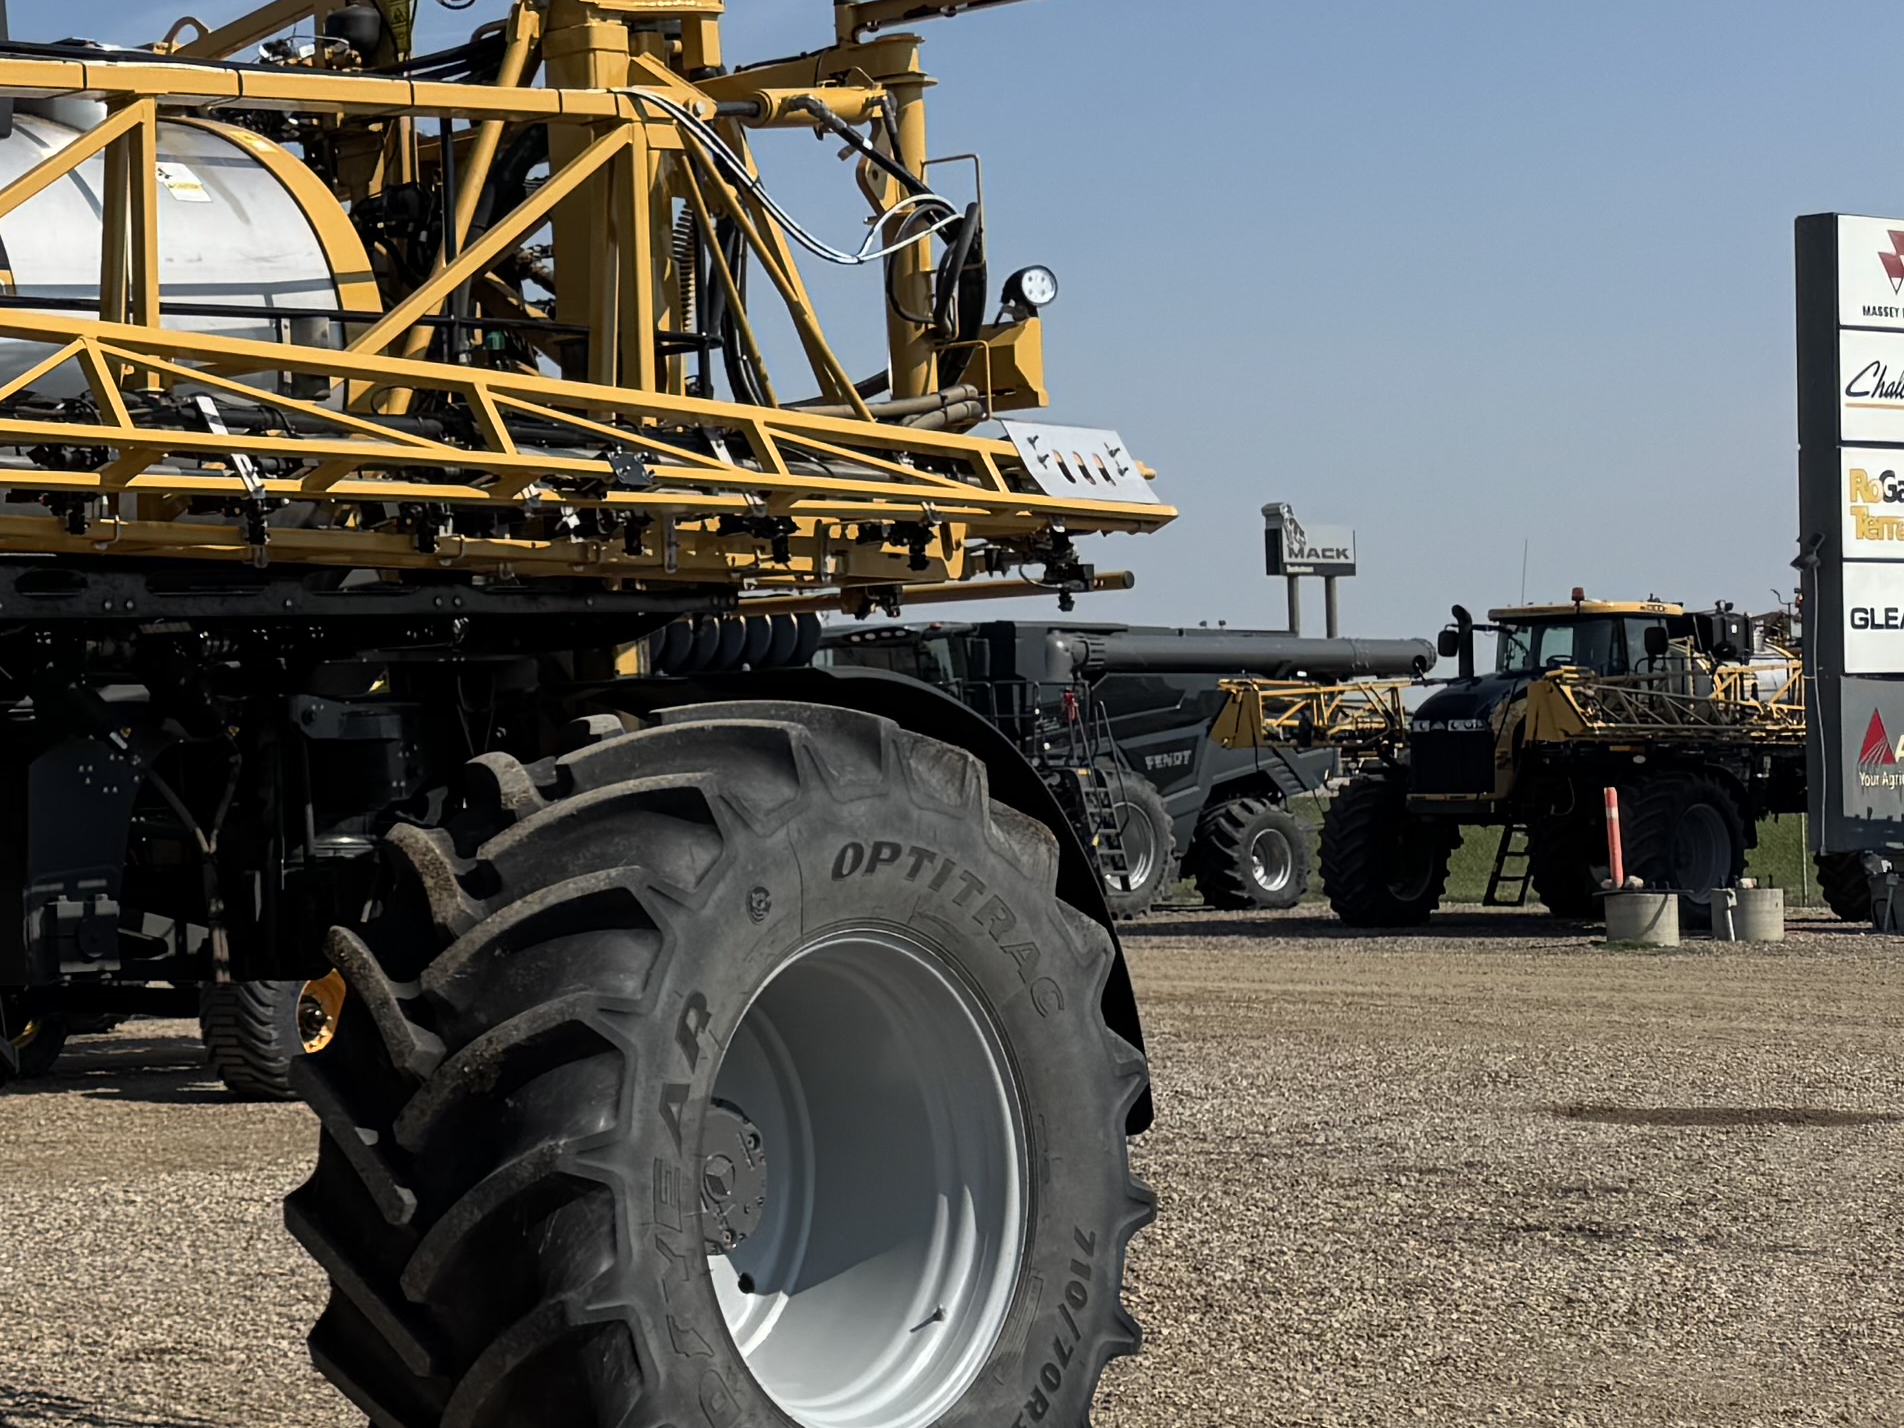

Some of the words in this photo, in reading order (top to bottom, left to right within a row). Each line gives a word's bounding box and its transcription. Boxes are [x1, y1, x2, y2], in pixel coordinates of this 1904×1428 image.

[1862, 305, 1900, 318] MASSEY
[1287, 545, 1350, 560] MACK
[1850, 607, 1904, 630] GLE
[1144, 749, 1192, 771] FENDT
[1859, 771, 1879, 786] Your
[830, 841, 1065, 1018] OPTITRAC
